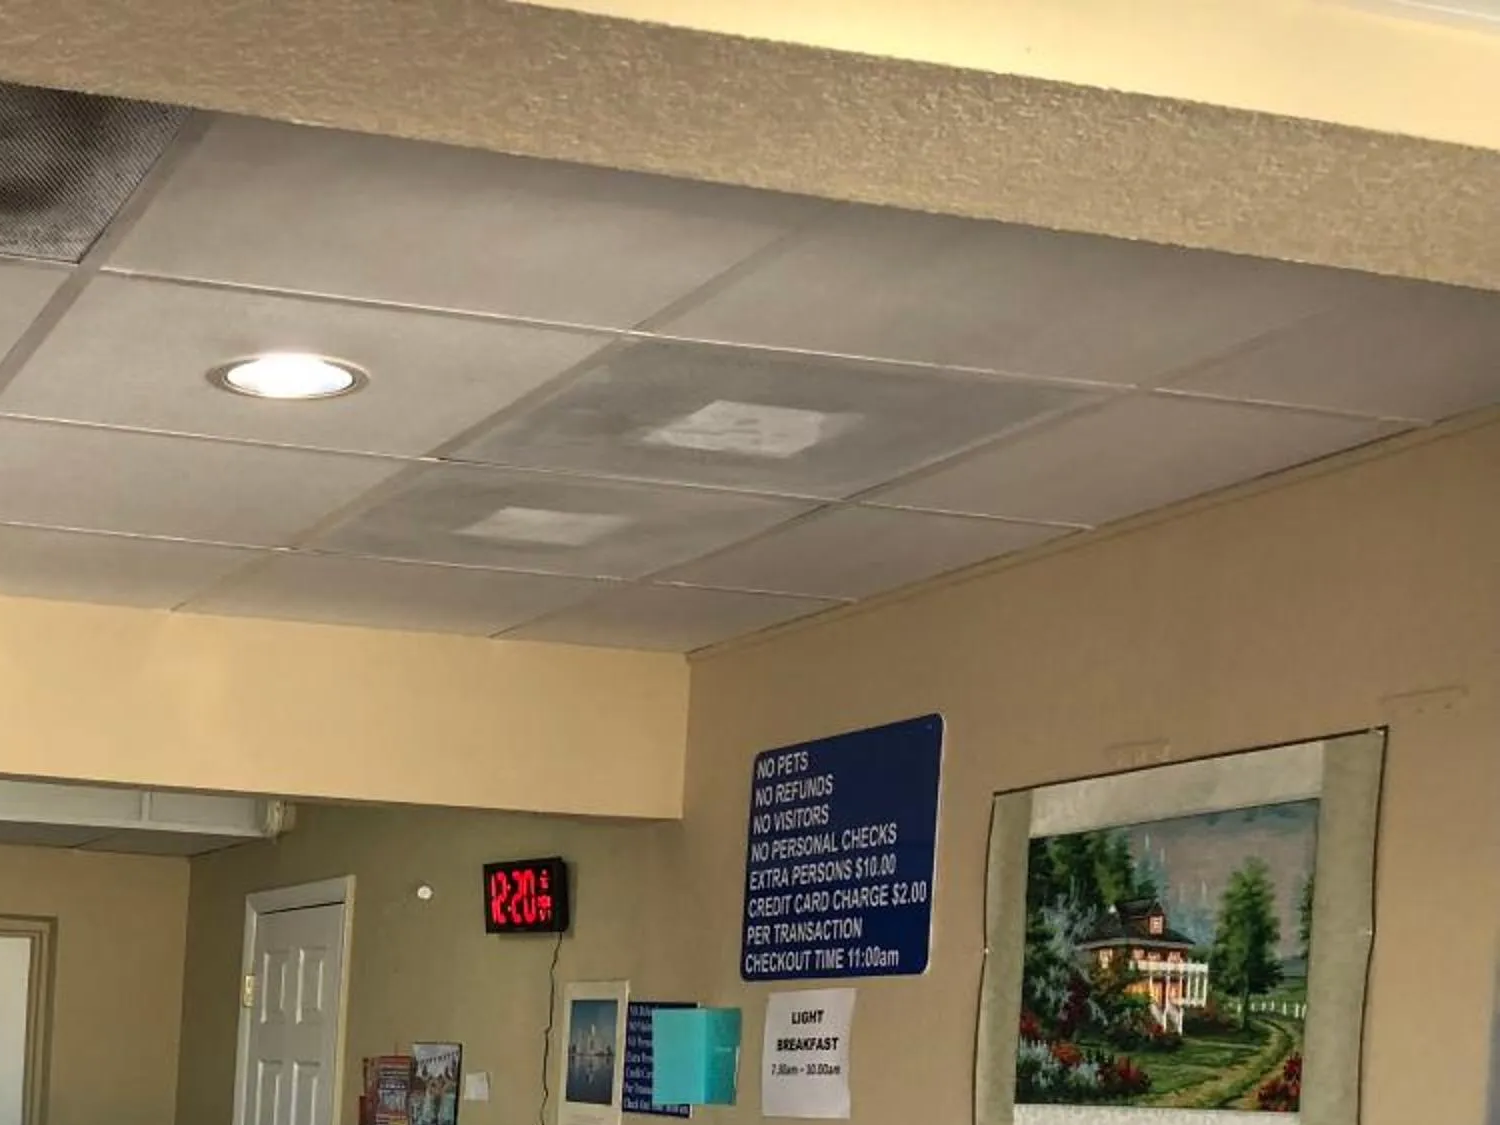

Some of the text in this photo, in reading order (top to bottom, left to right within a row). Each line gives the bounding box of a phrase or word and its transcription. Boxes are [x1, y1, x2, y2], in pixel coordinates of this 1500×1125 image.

[757, 751, 809, 779] NO PETS
[755, 774, 834, 807] NO REFUNDS
[754, 804, 829, 835] NO VISITORS
[752, 824, 897, 862] NO PERSONAL CHECKS
[750, 854, 896, 891] EXTRA PERSONS $10.00
[748, 880, 927, 918] CREDIT CARD CHARGE $2.00
[747, 917, 862, 945] PER TRANSACTION
[745, 946, 899, 974] CHECKOUT TIME 11:00am
[791, 1010, 824, 1025] LIGHT
[776, 1037, 840, 1052] BREAKFAST
